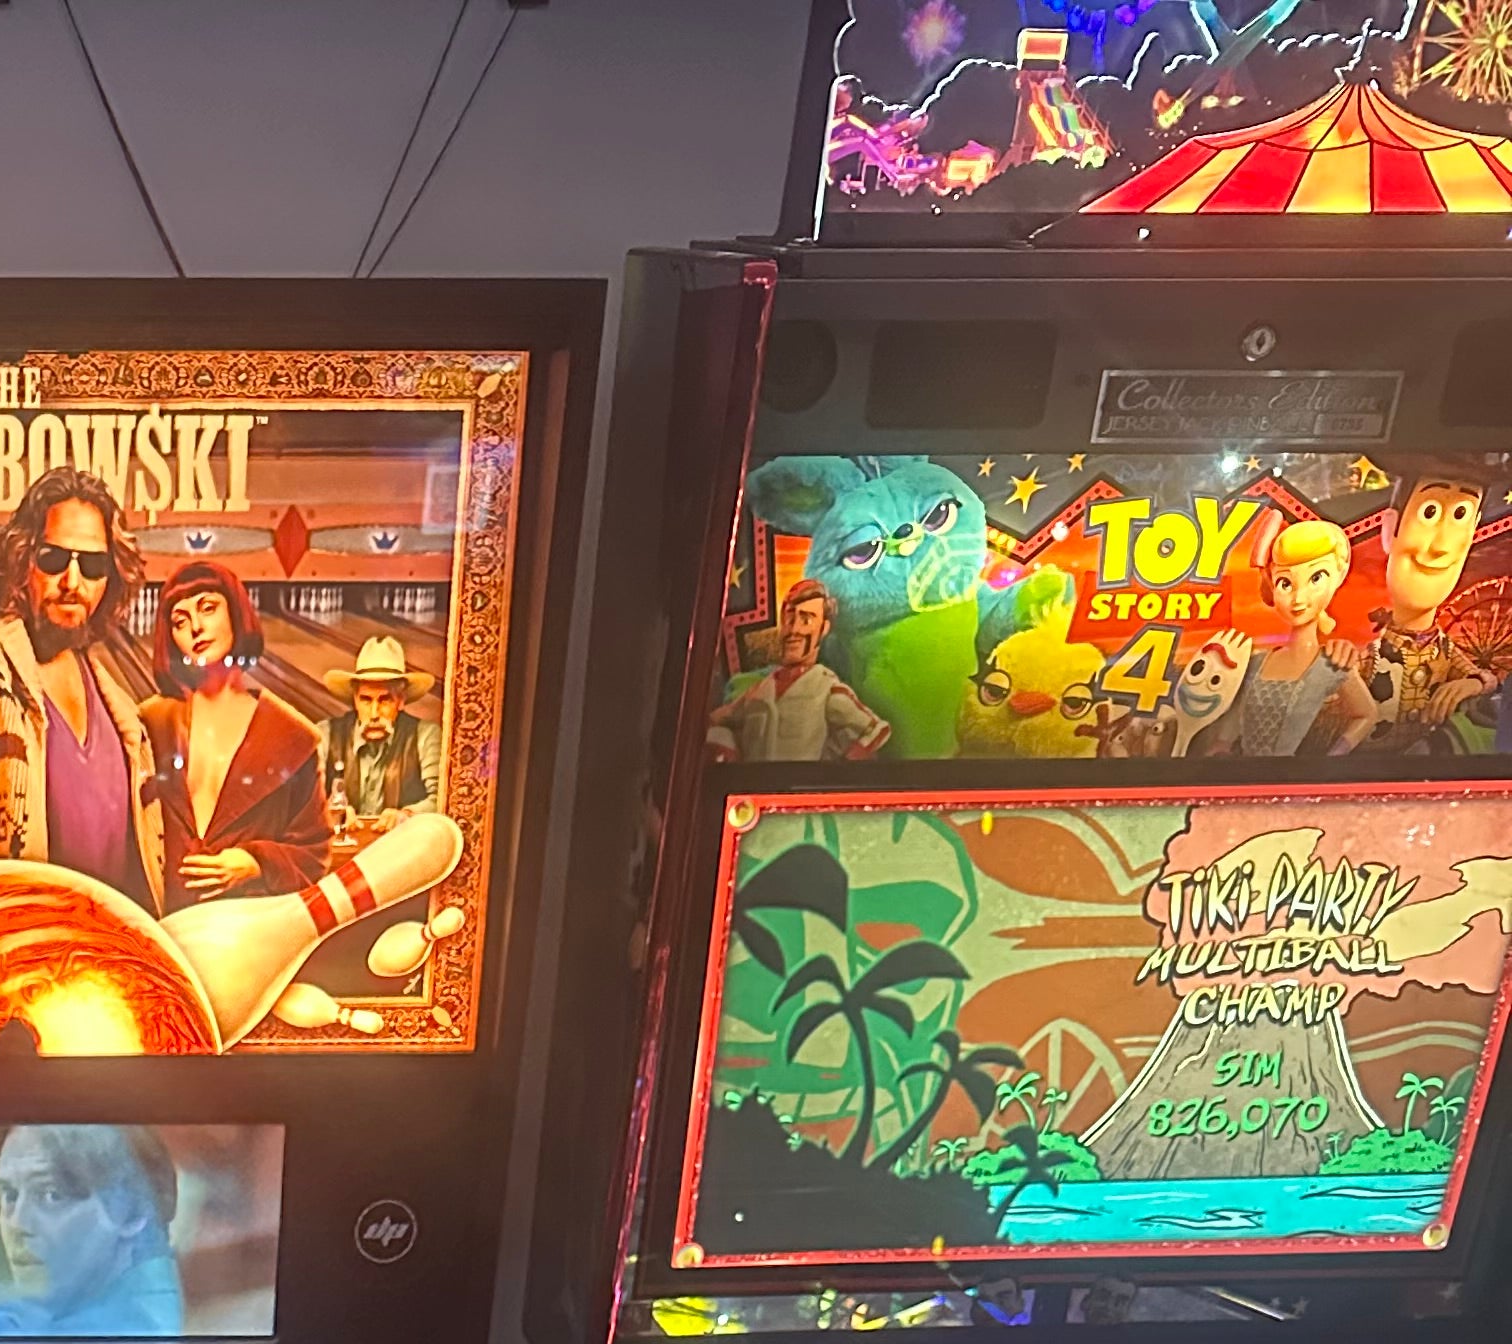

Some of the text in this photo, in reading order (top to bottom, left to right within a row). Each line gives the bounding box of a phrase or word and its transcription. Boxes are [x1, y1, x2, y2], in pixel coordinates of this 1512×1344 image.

[1086, 494, 1267, 588] TOY
[1087, 592, 1223, 620] STORY
[1099, 627, 1180, 715] 4
[1264, 851, 1421, 937] PARTY
[1136, 938, 1404, 985] MULTIBALL
[1182, 982, 1347, 1027] CHAMP
[1212, 1050, 1285, 1088] SIM
[1146, 1095, 1330, 1141] 826,070
